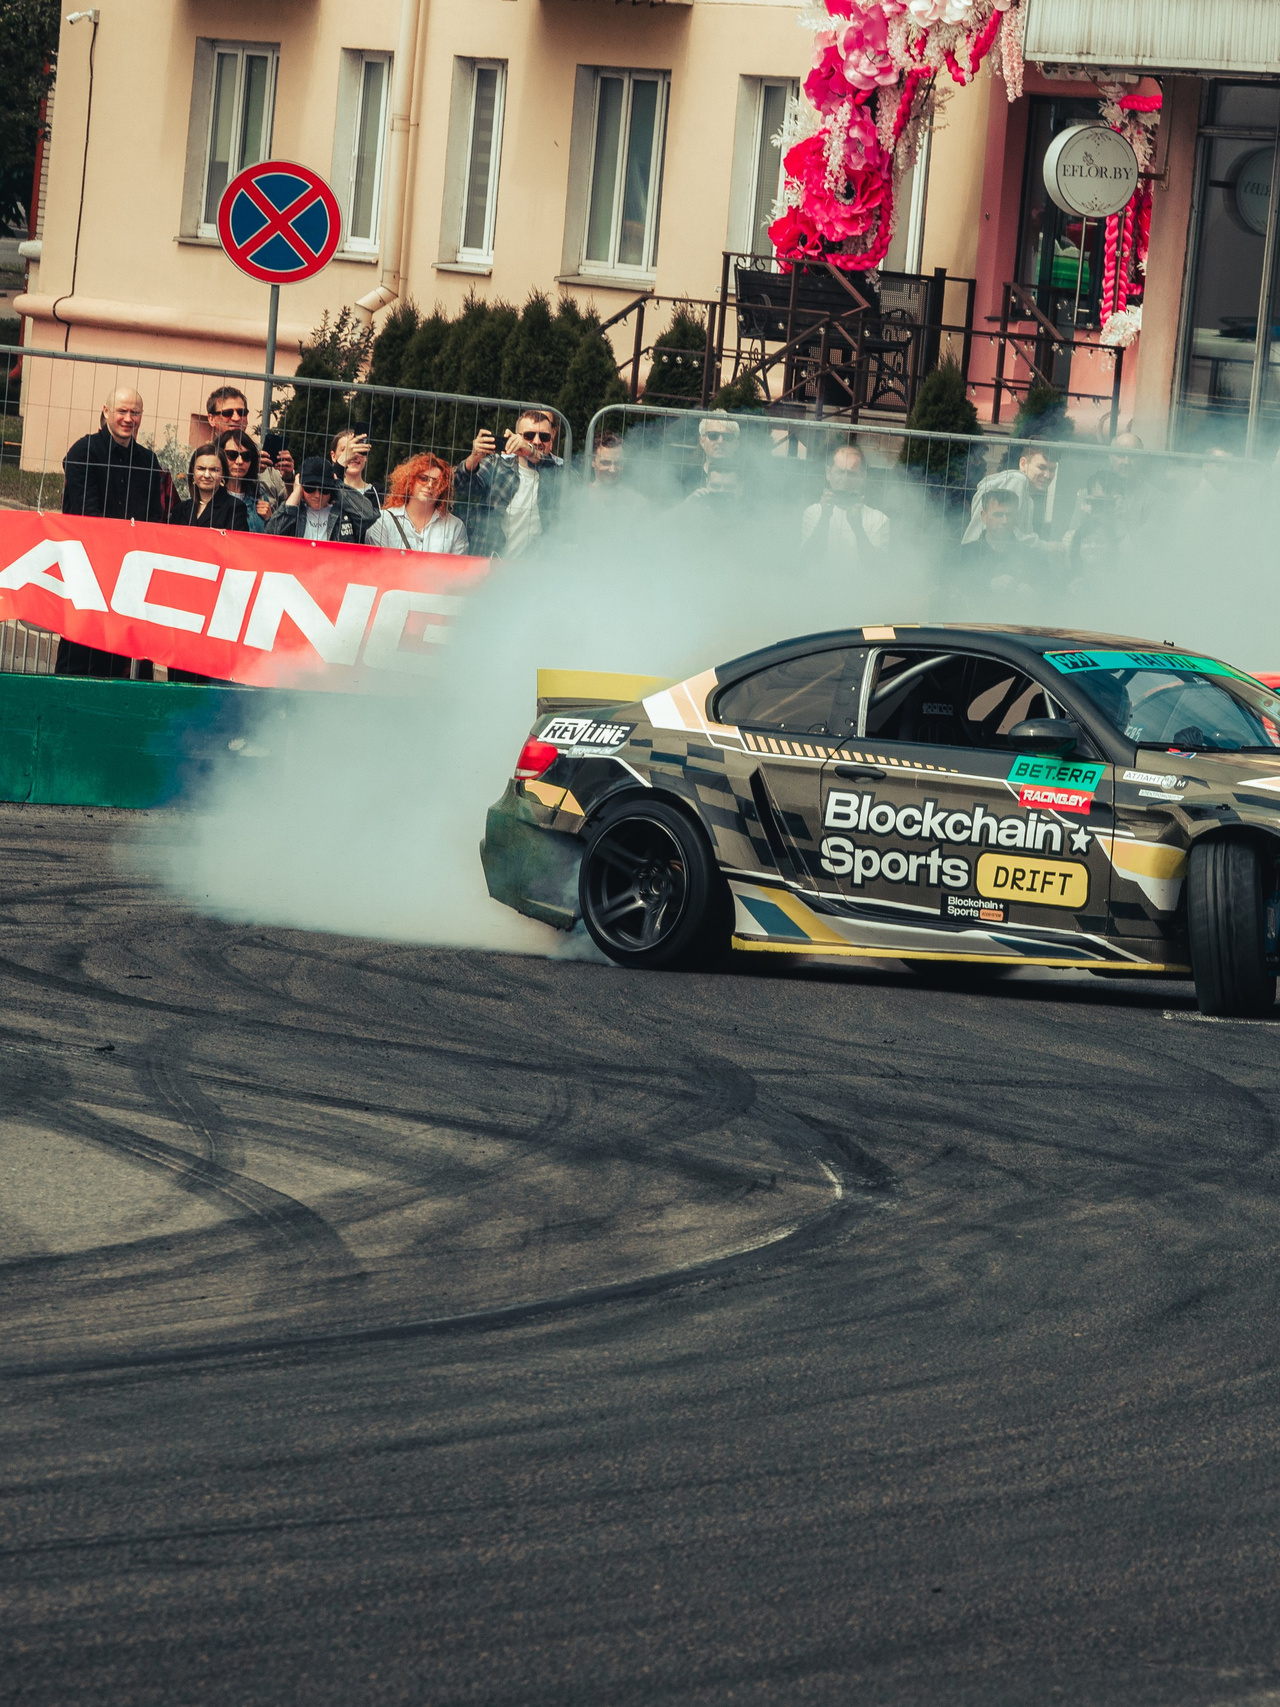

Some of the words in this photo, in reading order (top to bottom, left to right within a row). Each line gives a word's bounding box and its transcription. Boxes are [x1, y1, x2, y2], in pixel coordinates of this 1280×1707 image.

[1062, 163, 1132, 180] EFLOR.BY
[1054, 652, 1093, 668] 999
[1015, 762, 1097, 784] BET.ERA
[1126, 771, 1161, 784] АТЛАНТ
[1023, 789, 1088, 807] RACING.BY
[824, 791, 1061, 851] Blockchain
[820, 837, 969, 888] Sports
[993, 866, 1073, 896] DRIFT
[947, 895, 998, 910] Blockchain
[947, 905, 979, 917] Sports
